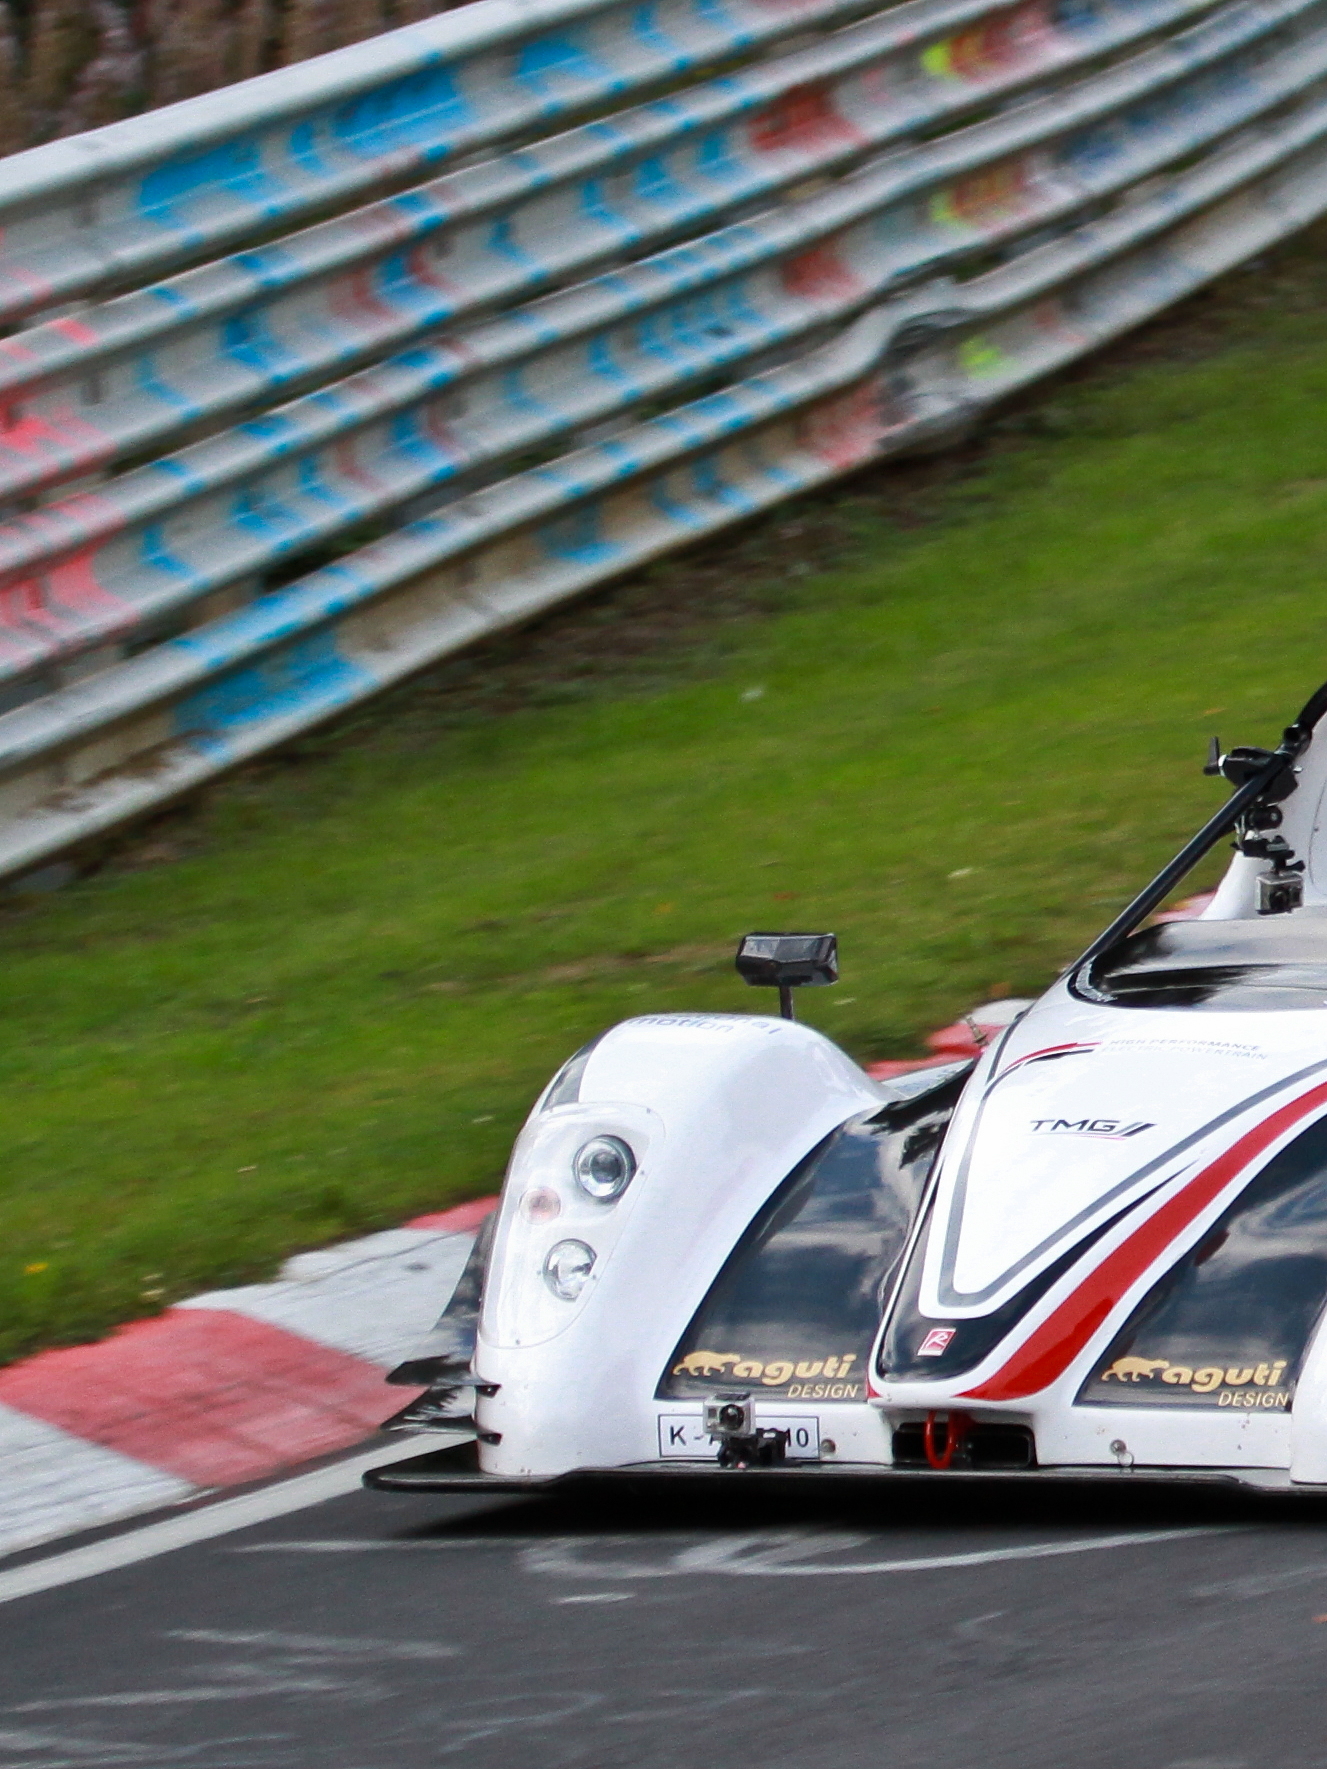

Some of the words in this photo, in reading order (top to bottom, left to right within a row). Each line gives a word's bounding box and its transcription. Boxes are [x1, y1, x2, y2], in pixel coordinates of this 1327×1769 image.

[1029, 1118, 1128, 1134] TMG
[732, 1353, 858, 1386] aguti
[1161, 1359, 1288, 1394] aguti
[786, 1383, 860, 1400] DESIGN
[1216, 1390, 1290, 1408] DESIGN
